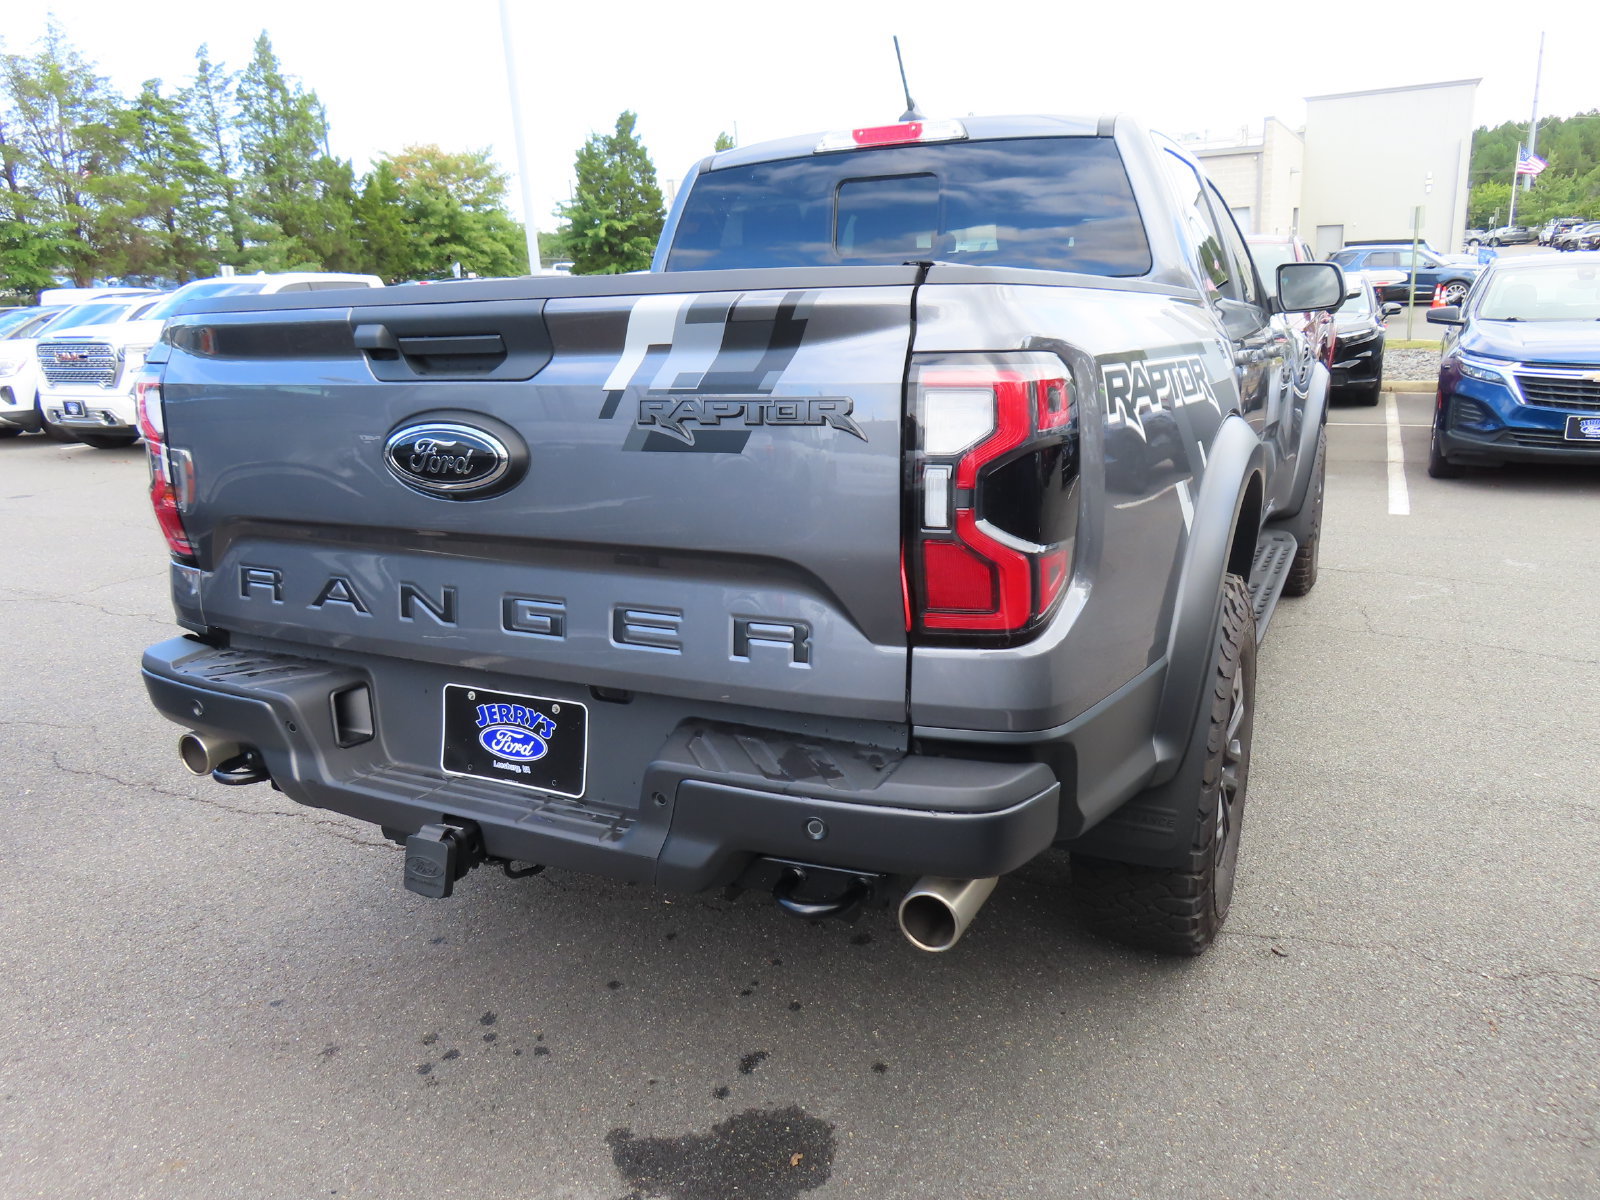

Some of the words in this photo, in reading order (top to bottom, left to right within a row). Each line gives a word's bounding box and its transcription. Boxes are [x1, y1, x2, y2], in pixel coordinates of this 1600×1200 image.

[1101, 354, 1221, 443] RAPTOR
[638, 396, 868, 446] RAPTOR
[410, 438, 473, 474] Ford
[238, 563, 812, 669] RANGER
[476, 703, 557, 739] JERRY'S
[491, 729, 535, 757] Ford
